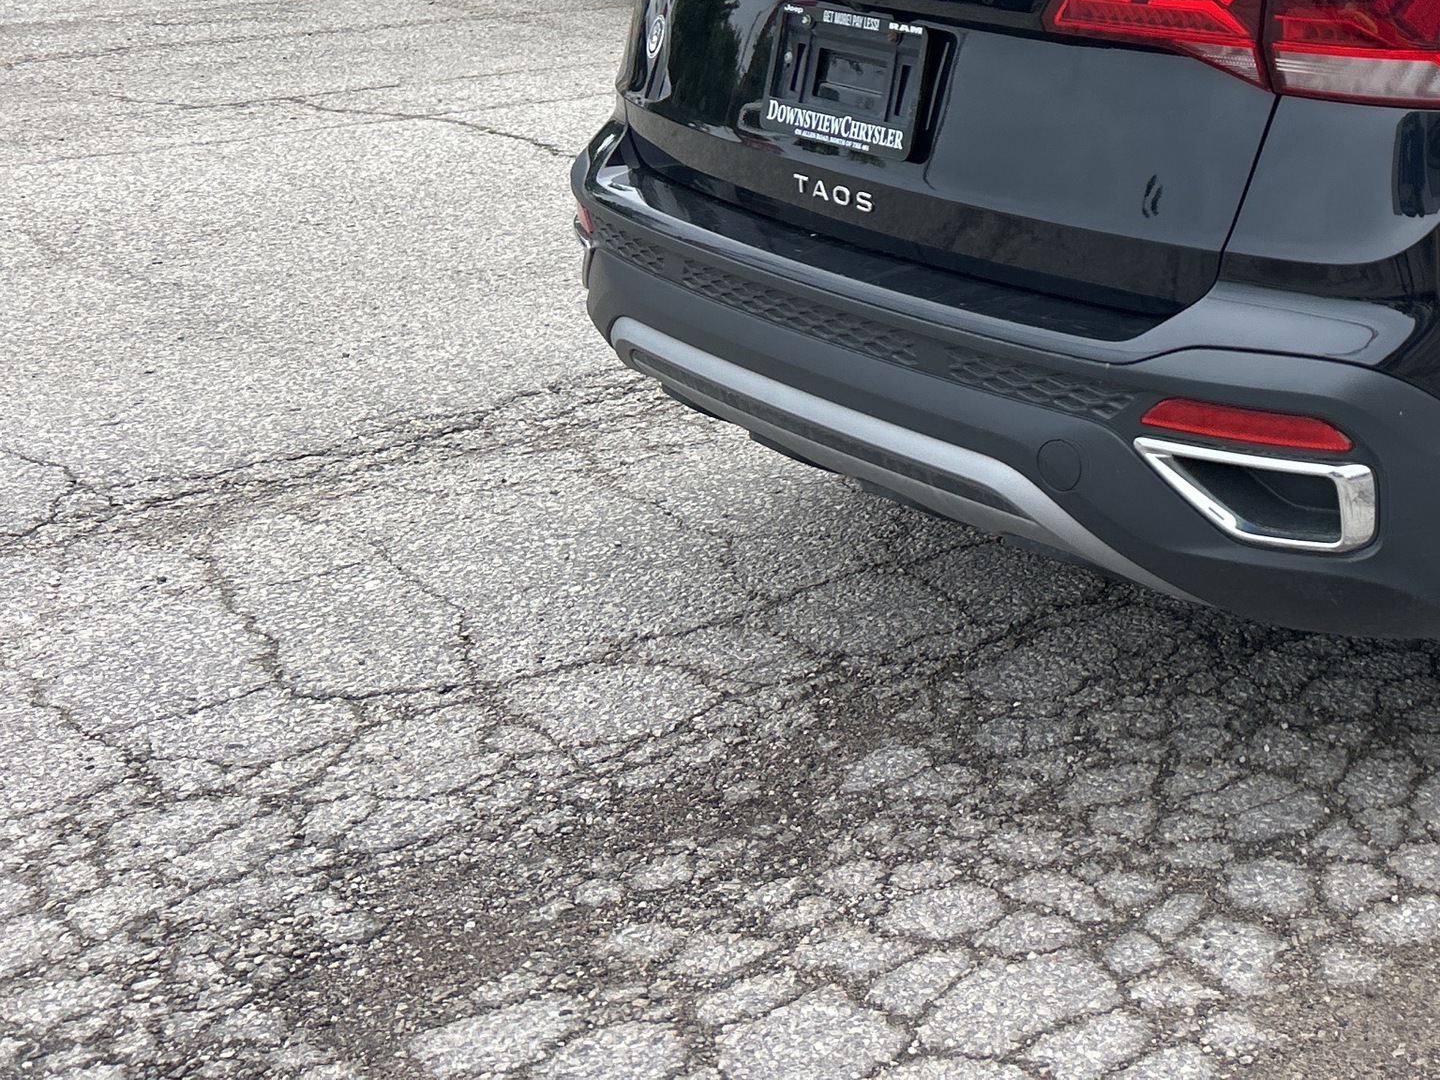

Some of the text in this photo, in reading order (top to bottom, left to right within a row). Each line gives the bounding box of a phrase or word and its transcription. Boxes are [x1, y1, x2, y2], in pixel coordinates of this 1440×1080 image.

[784, 4, 804, 14] Jeep
[888, 22, 923, 35] RAM
[793, 173, 875, 213] TAOS
